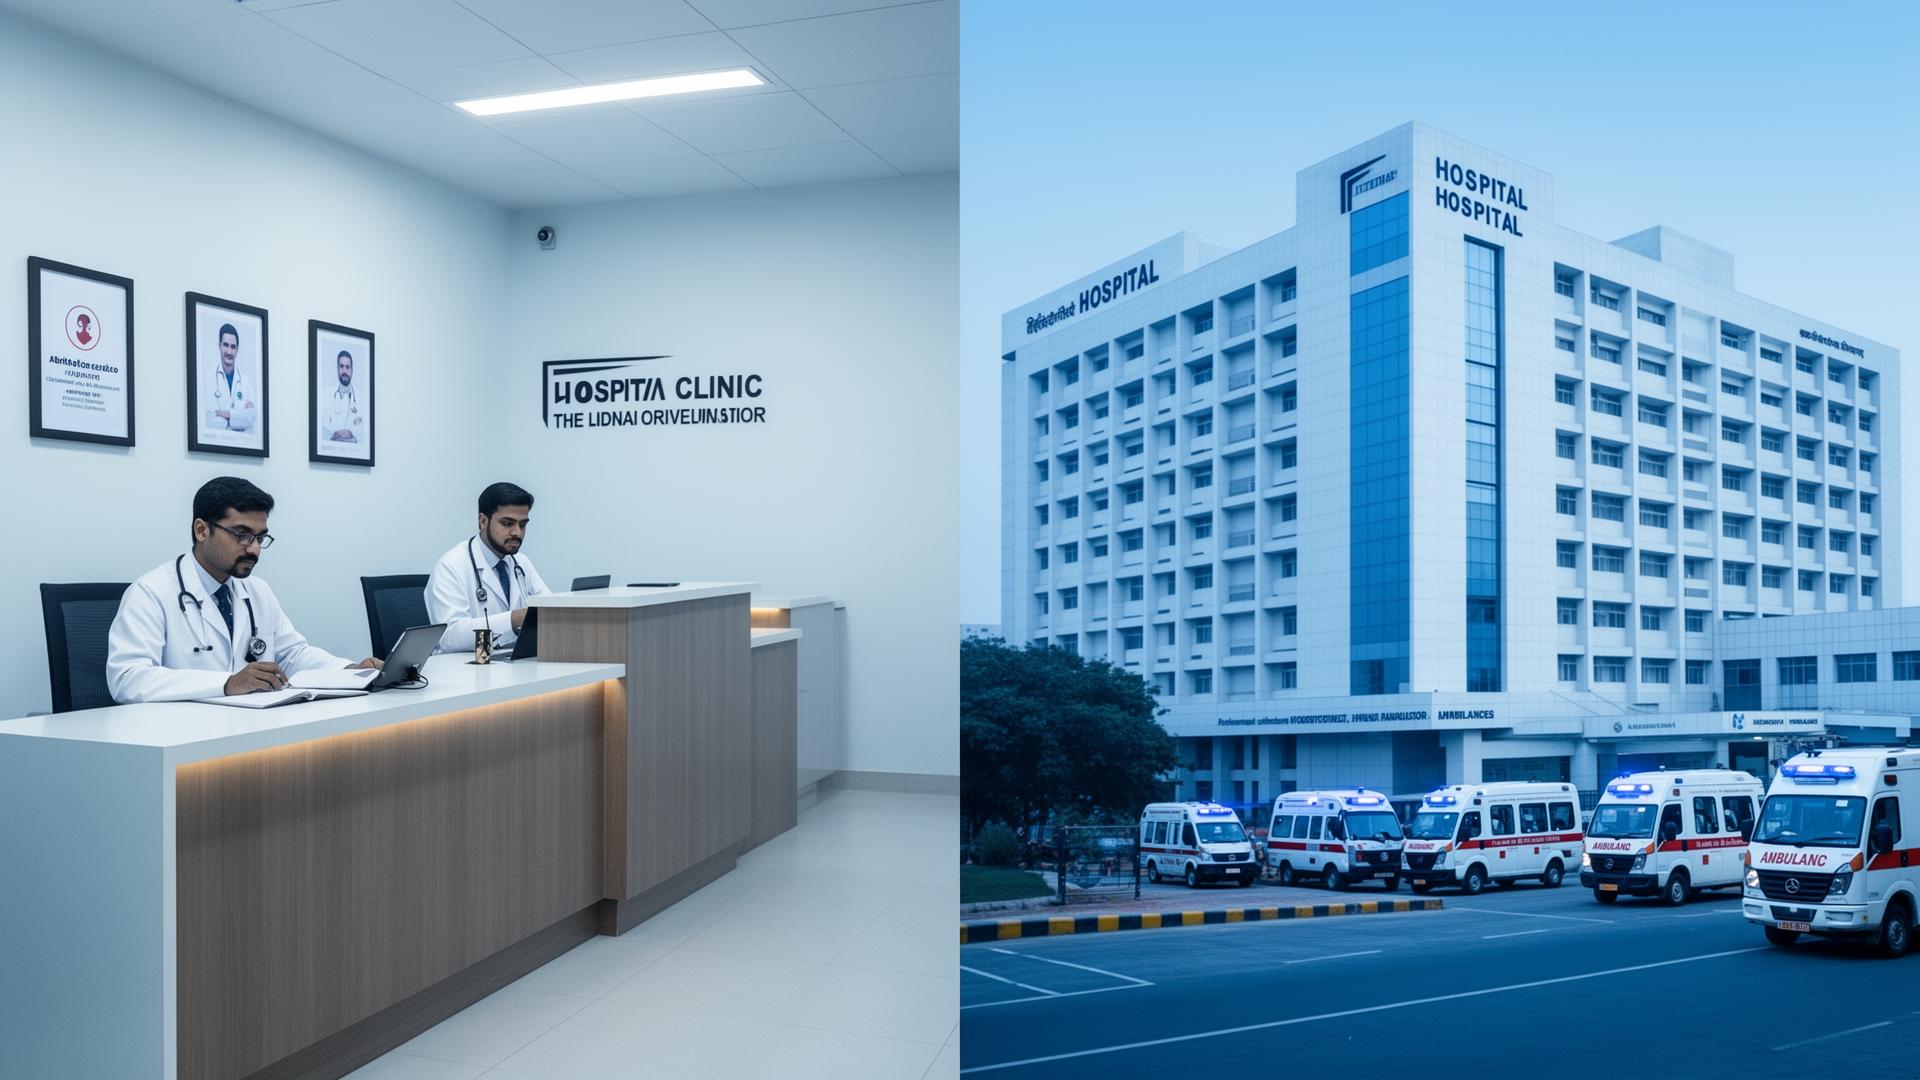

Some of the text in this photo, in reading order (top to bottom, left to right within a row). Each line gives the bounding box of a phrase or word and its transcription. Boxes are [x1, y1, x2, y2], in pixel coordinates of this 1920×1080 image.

[1435, 156, 1528, 211] HOSPITAL
[1435, 186, 1523, 237] HOSPITAL
[1079, 259, 1160, 314] HOSPITAL
[675, 374, 763, 400] CLINIC
[553, 412, 584, 429] THE
